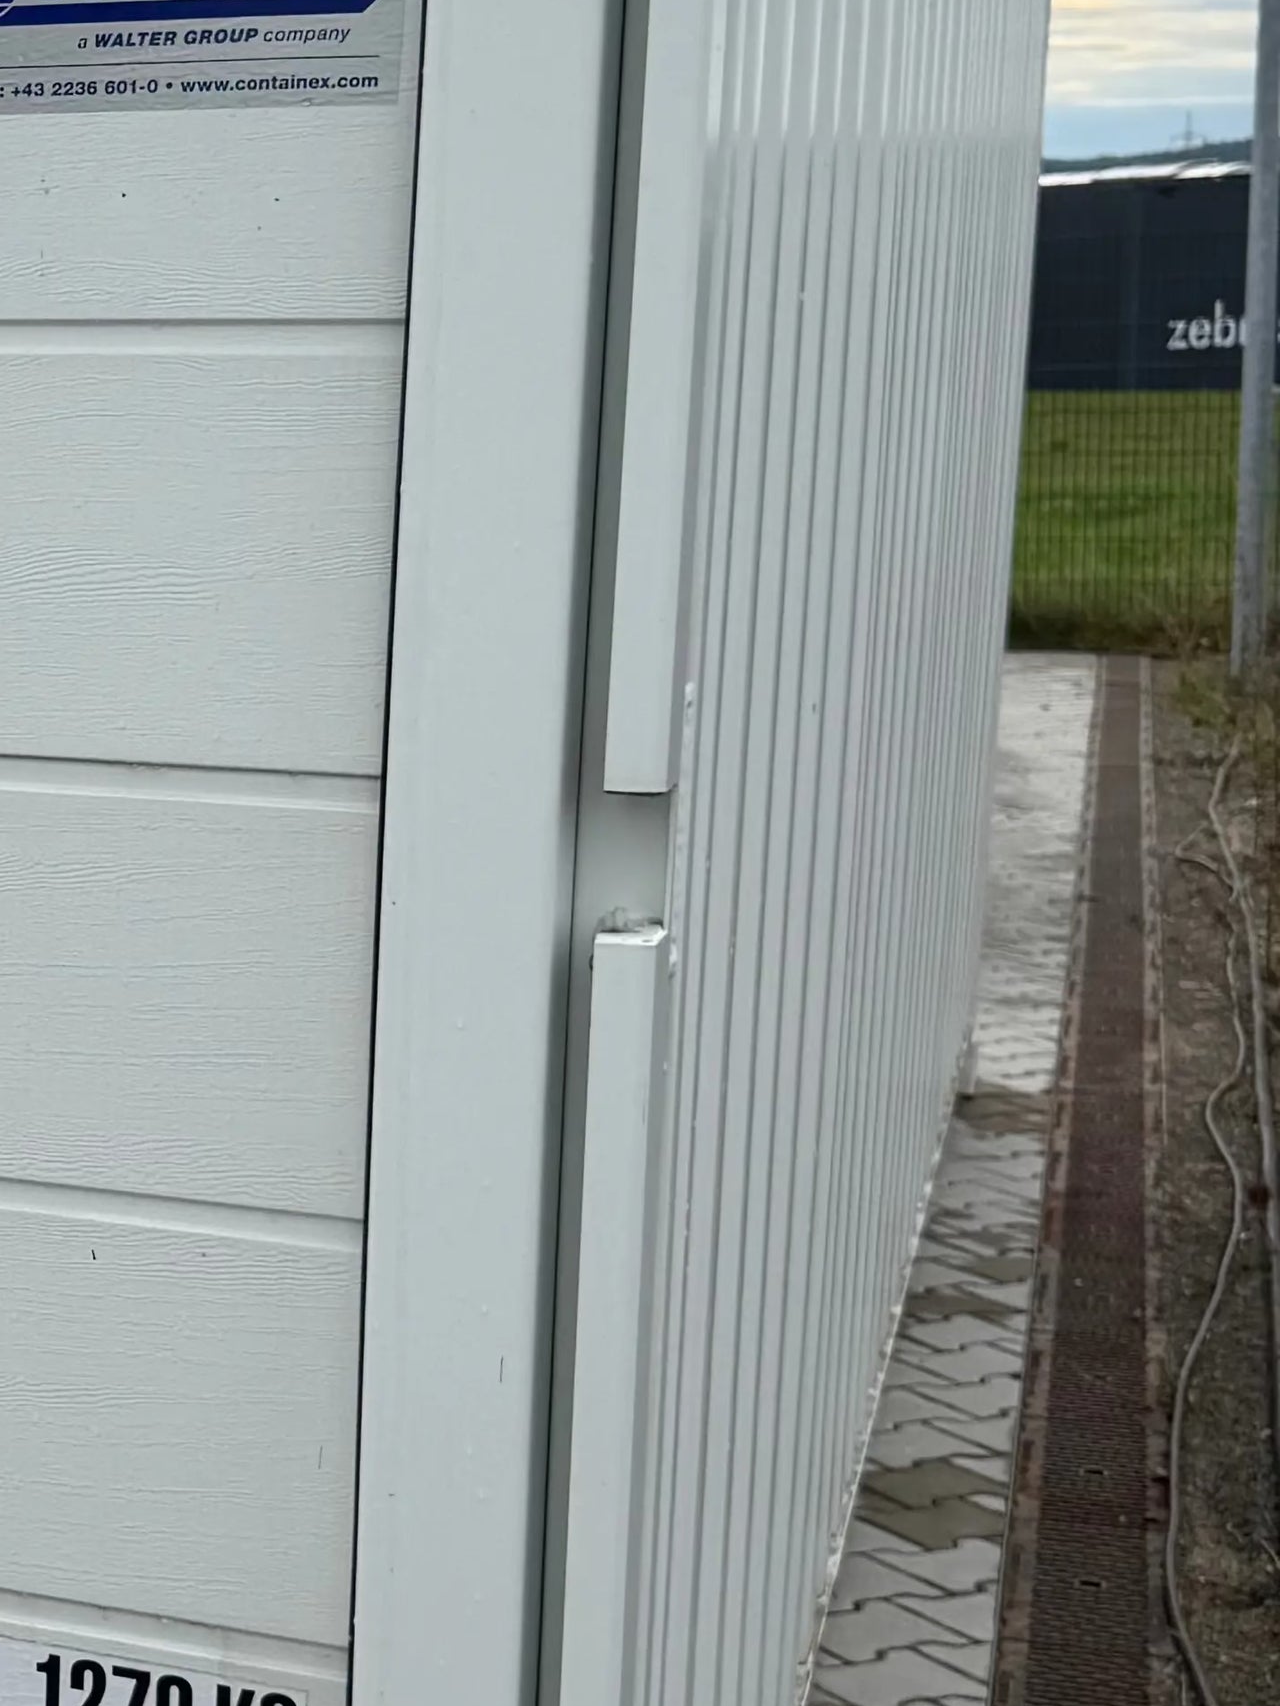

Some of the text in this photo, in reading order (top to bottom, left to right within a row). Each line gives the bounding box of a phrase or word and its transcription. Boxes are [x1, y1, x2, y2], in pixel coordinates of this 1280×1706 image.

[77, 27, 352, 50] a WALTER GROUP company
[11, 82, 45, 97] +43
[51, 80, 98, 96] 2236
[105, 79, 159, 95] 601-0
[180, 74, 380, 92] www.containex.com
